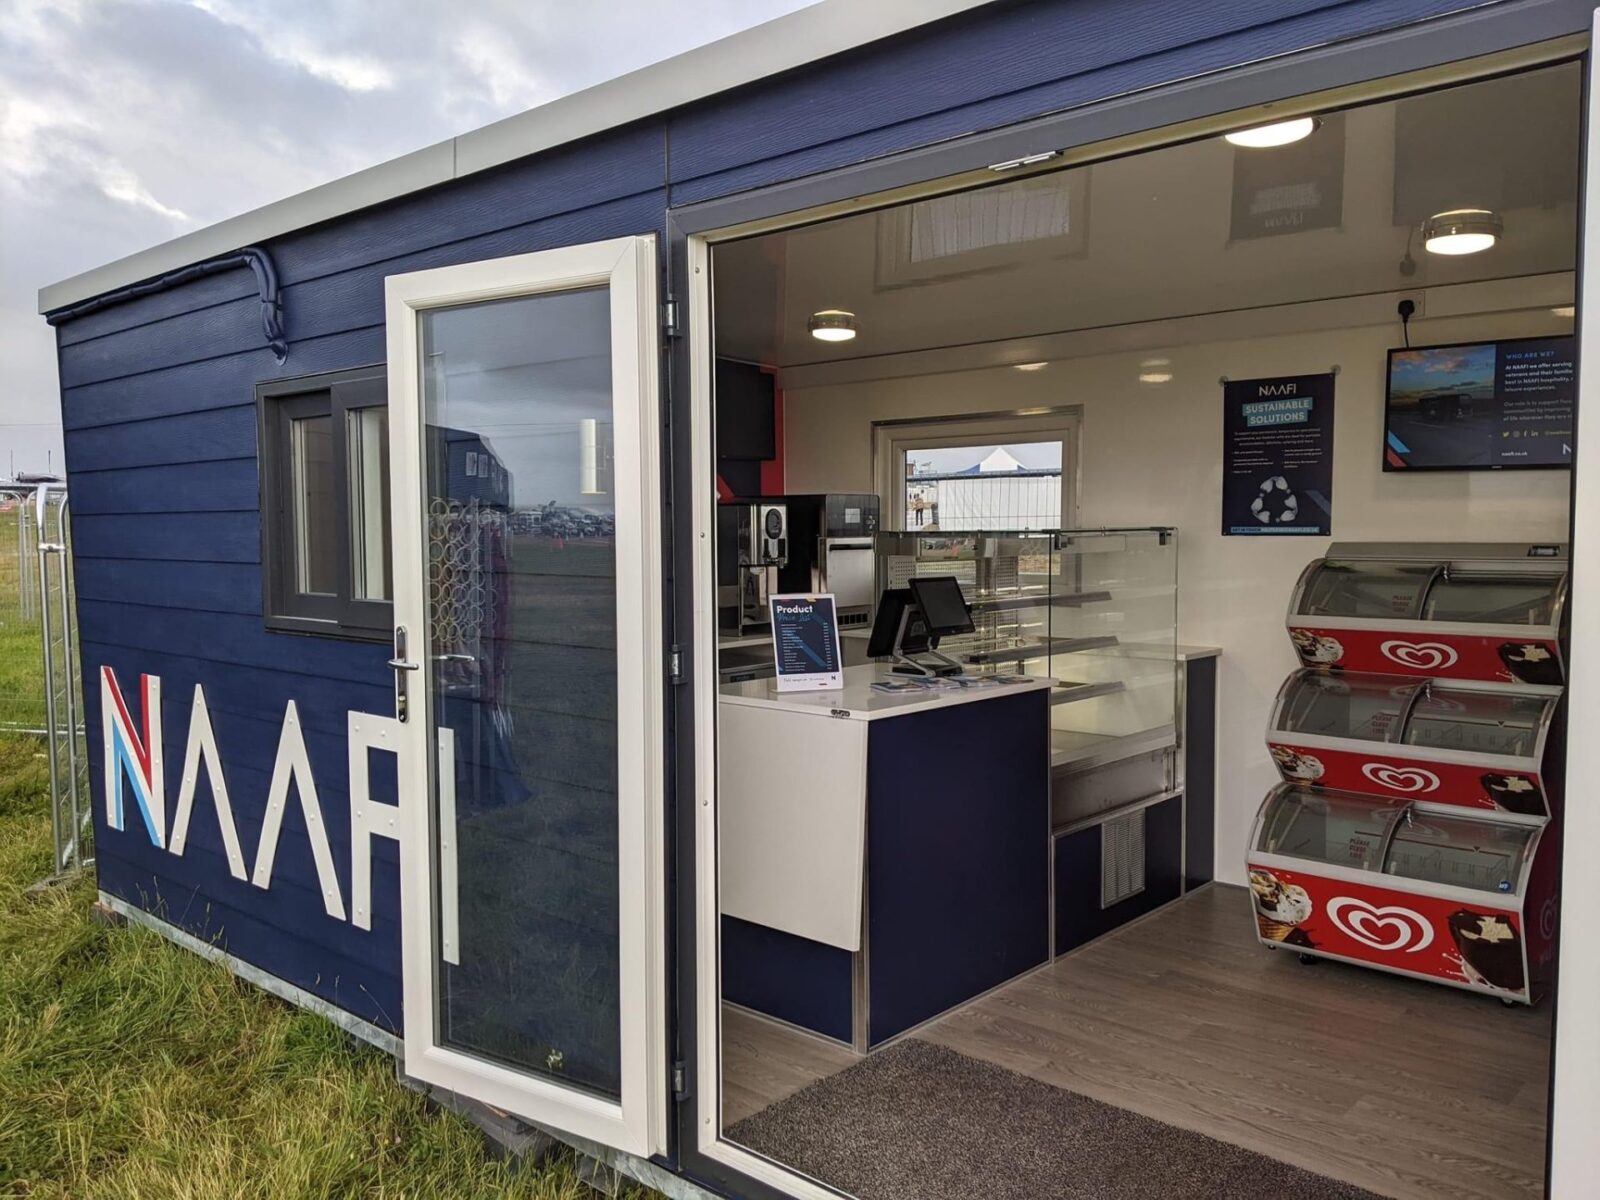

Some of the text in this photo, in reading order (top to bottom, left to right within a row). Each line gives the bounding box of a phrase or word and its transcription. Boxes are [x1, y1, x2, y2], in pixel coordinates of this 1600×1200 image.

[1258, 383, 1297, 397] NAAFI
[1246, 400, 1310, 414] SUSTAINABLE
[1249, 411, 1305, 425] SOLUTIONS
[776, 604, 813, 614] Product
